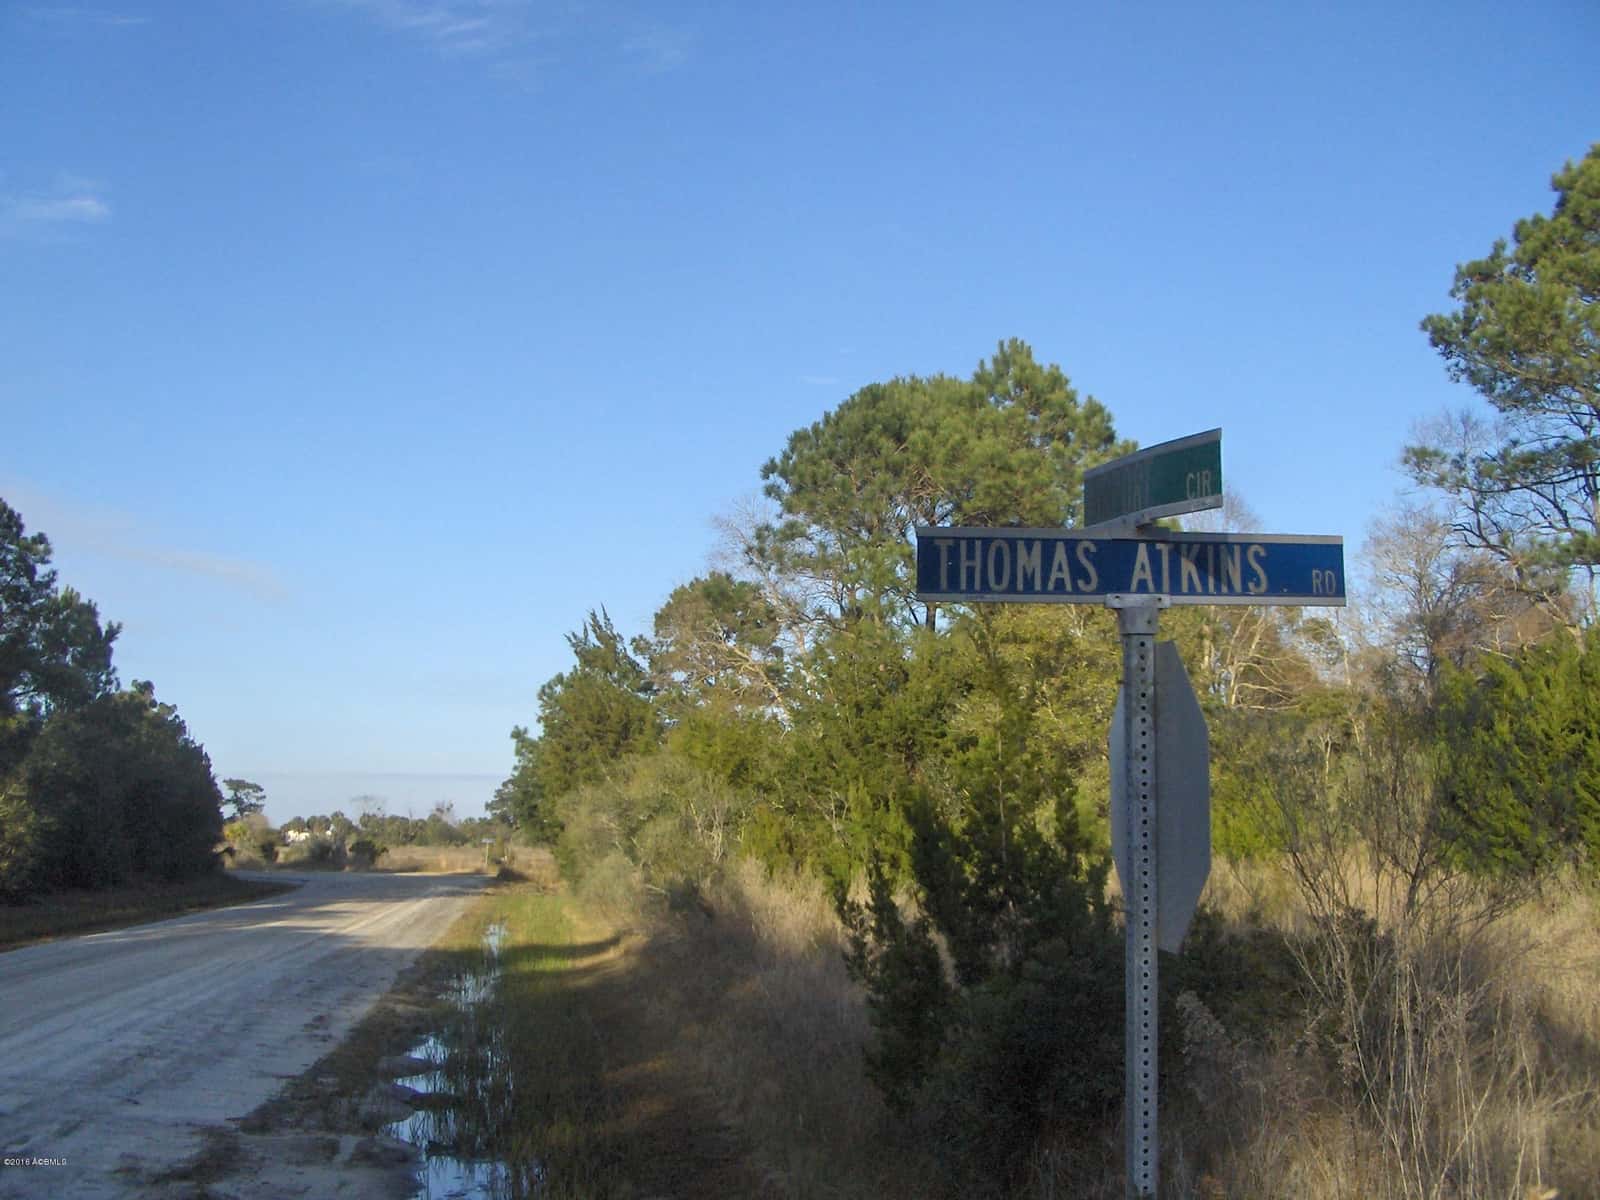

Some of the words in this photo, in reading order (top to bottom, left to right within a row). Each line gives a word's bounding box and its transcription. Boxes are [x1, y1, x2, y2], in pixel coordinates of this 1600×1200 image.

[1186, 470, 1212, 502] CIR
[934, 539, 1100, 594] THOMAS
[1129, 541, 1269, 594] ATKINS
[1312, 569, 1337, 596] RD
